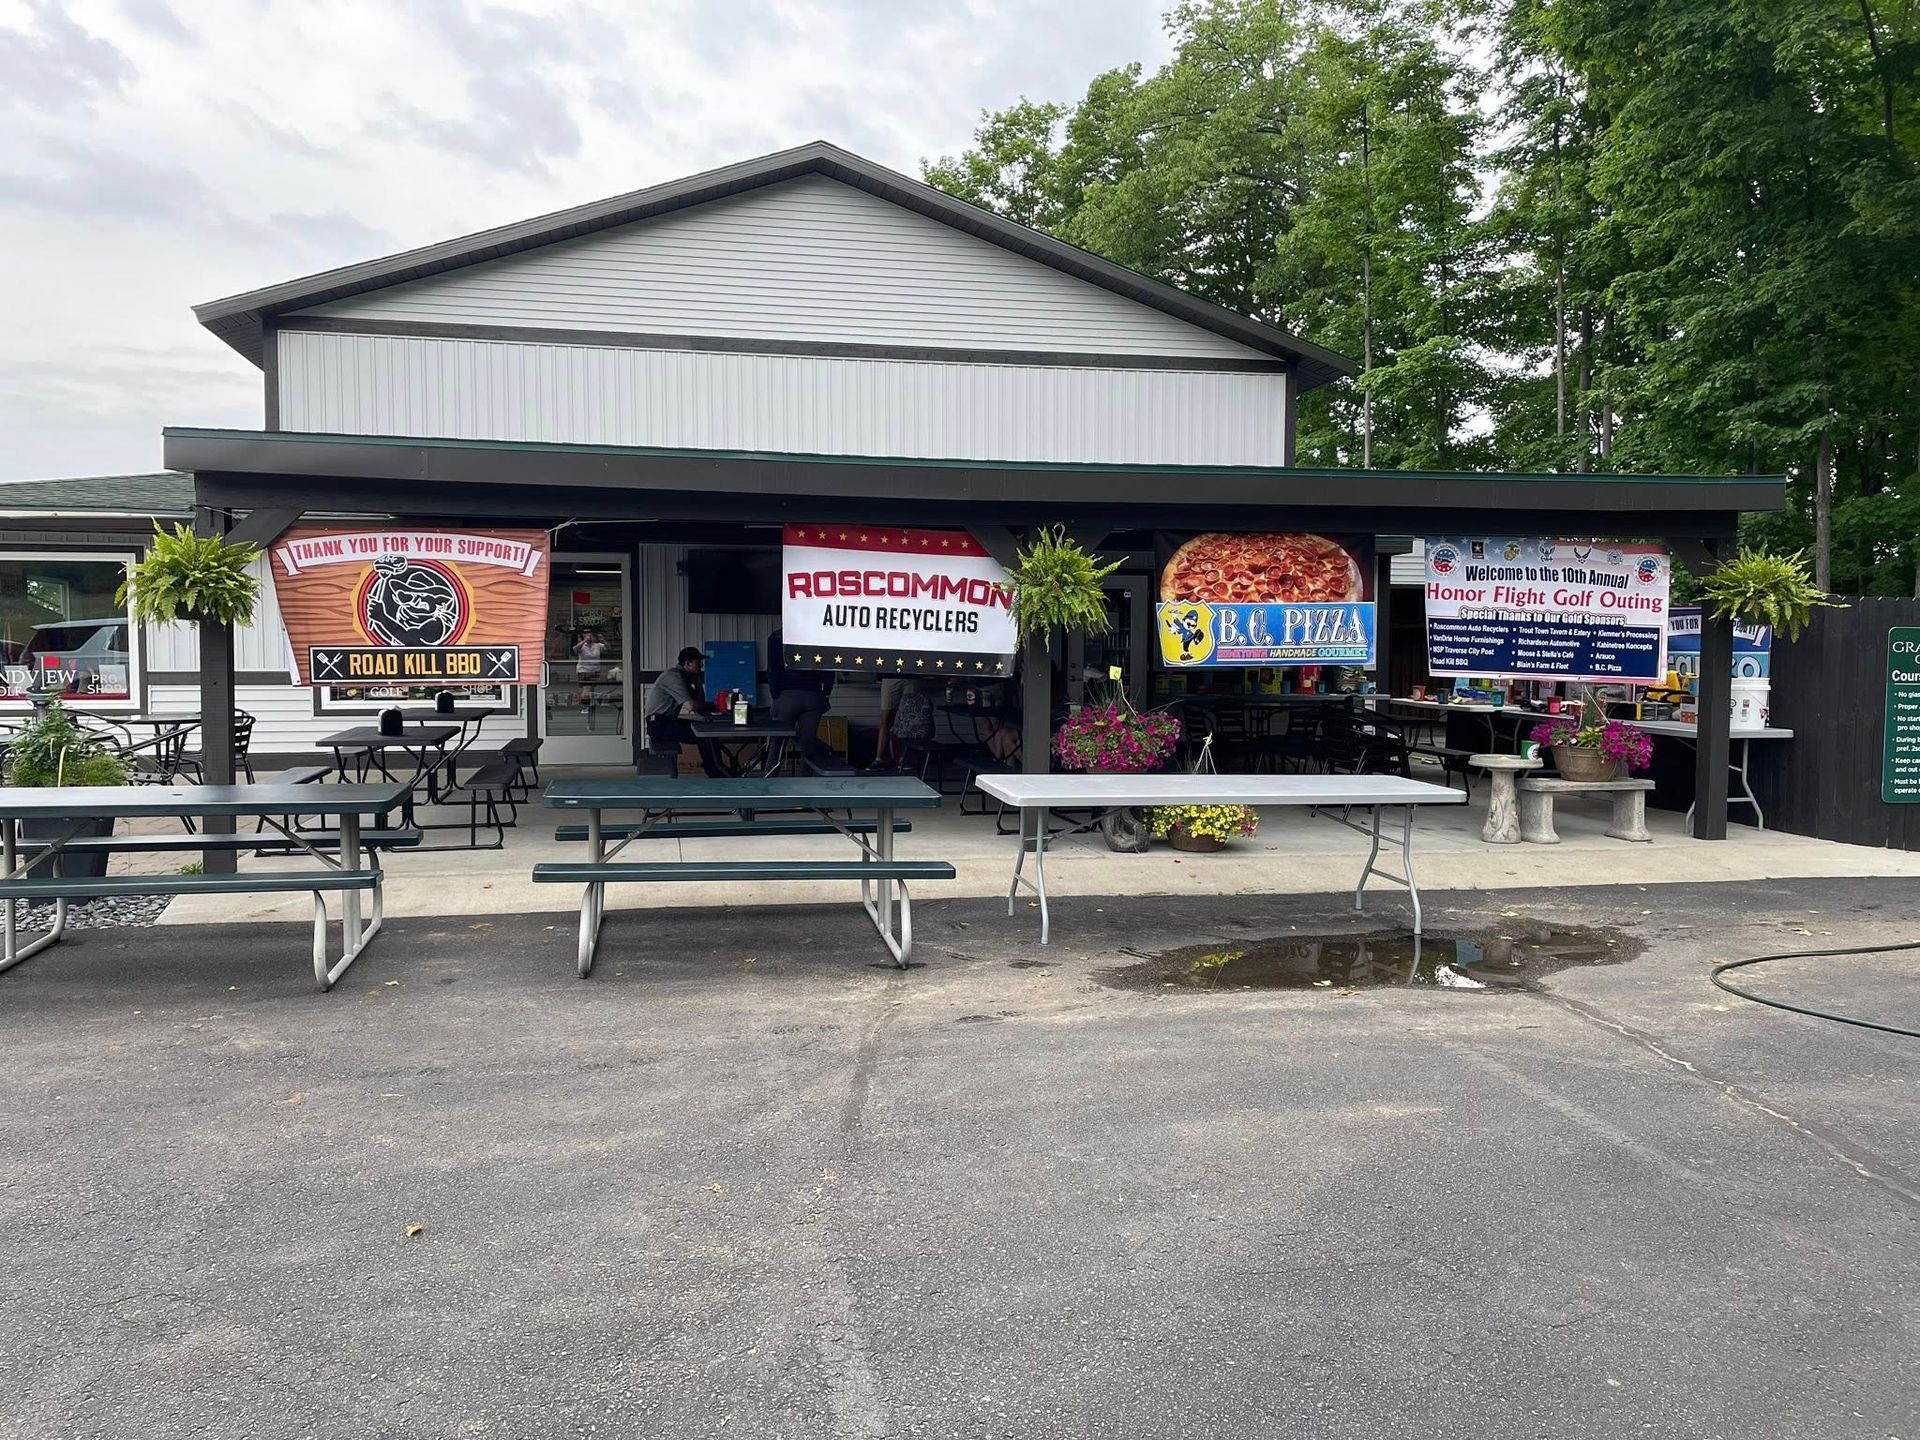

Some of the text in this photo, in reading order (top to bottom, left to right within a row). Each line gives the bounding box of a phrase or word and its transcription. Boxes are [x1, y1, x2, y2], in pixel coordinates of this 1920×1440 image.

[294, 537, 526, 562] THANK YOU FOR YOUR SUPPORT!
[1465, 565, 1523, 582] Welcome
[1526, 566, 1537, 581] to
[1540, 566, 1559, 582] the
[1561, 567, 1586, 584] 10th
[1589, 569, 1630, 589] Annual
[787, 570, 1016, 610] ROSCOMMON
[1427, 582, 1663, 613] Honor Flight Golf Outing
[823, 604, 979, 633] AUTO RECYCLERS
[1461, 608, 1625, 626] Special Thanks to Our Gold Sponsors
[1218, 607, 1367, 645] B.C. PIZZA
[1433, 622, 1509, 634] Roscommon Auto Recyclers
[1671, 618, 1699, 630] YOU FOR
[1534, 627, 1549, 635] Town
[1550, 628, 1568, 636] Tavern
[1573, 629, 1591, 638] Eatery
[1626, 631, 1658, 640] Processing
[1470, 637, 1505, 645] Furnishings
[1518, 638, 1549, 646] Richardson
[1468, 647, 1480, 656] City
[1626, 643, 1653, 651] Koncepts
[1270, 648, 1317, 658] HANDMADE
[1542, 650, 1561, 658] Stella's
[1595, 652, 1615, 660] Arauco
[350, 653, 481, 676] ROAD KILL BBQ
[1455, 658, 1469, 666] BBQ
[1607, 664, 1622, 672] Pizza
[91, 674, 117, 684] PRO
[88, 684, 122, 695] SHOP
[462, 684, 492, 694] SHOP
